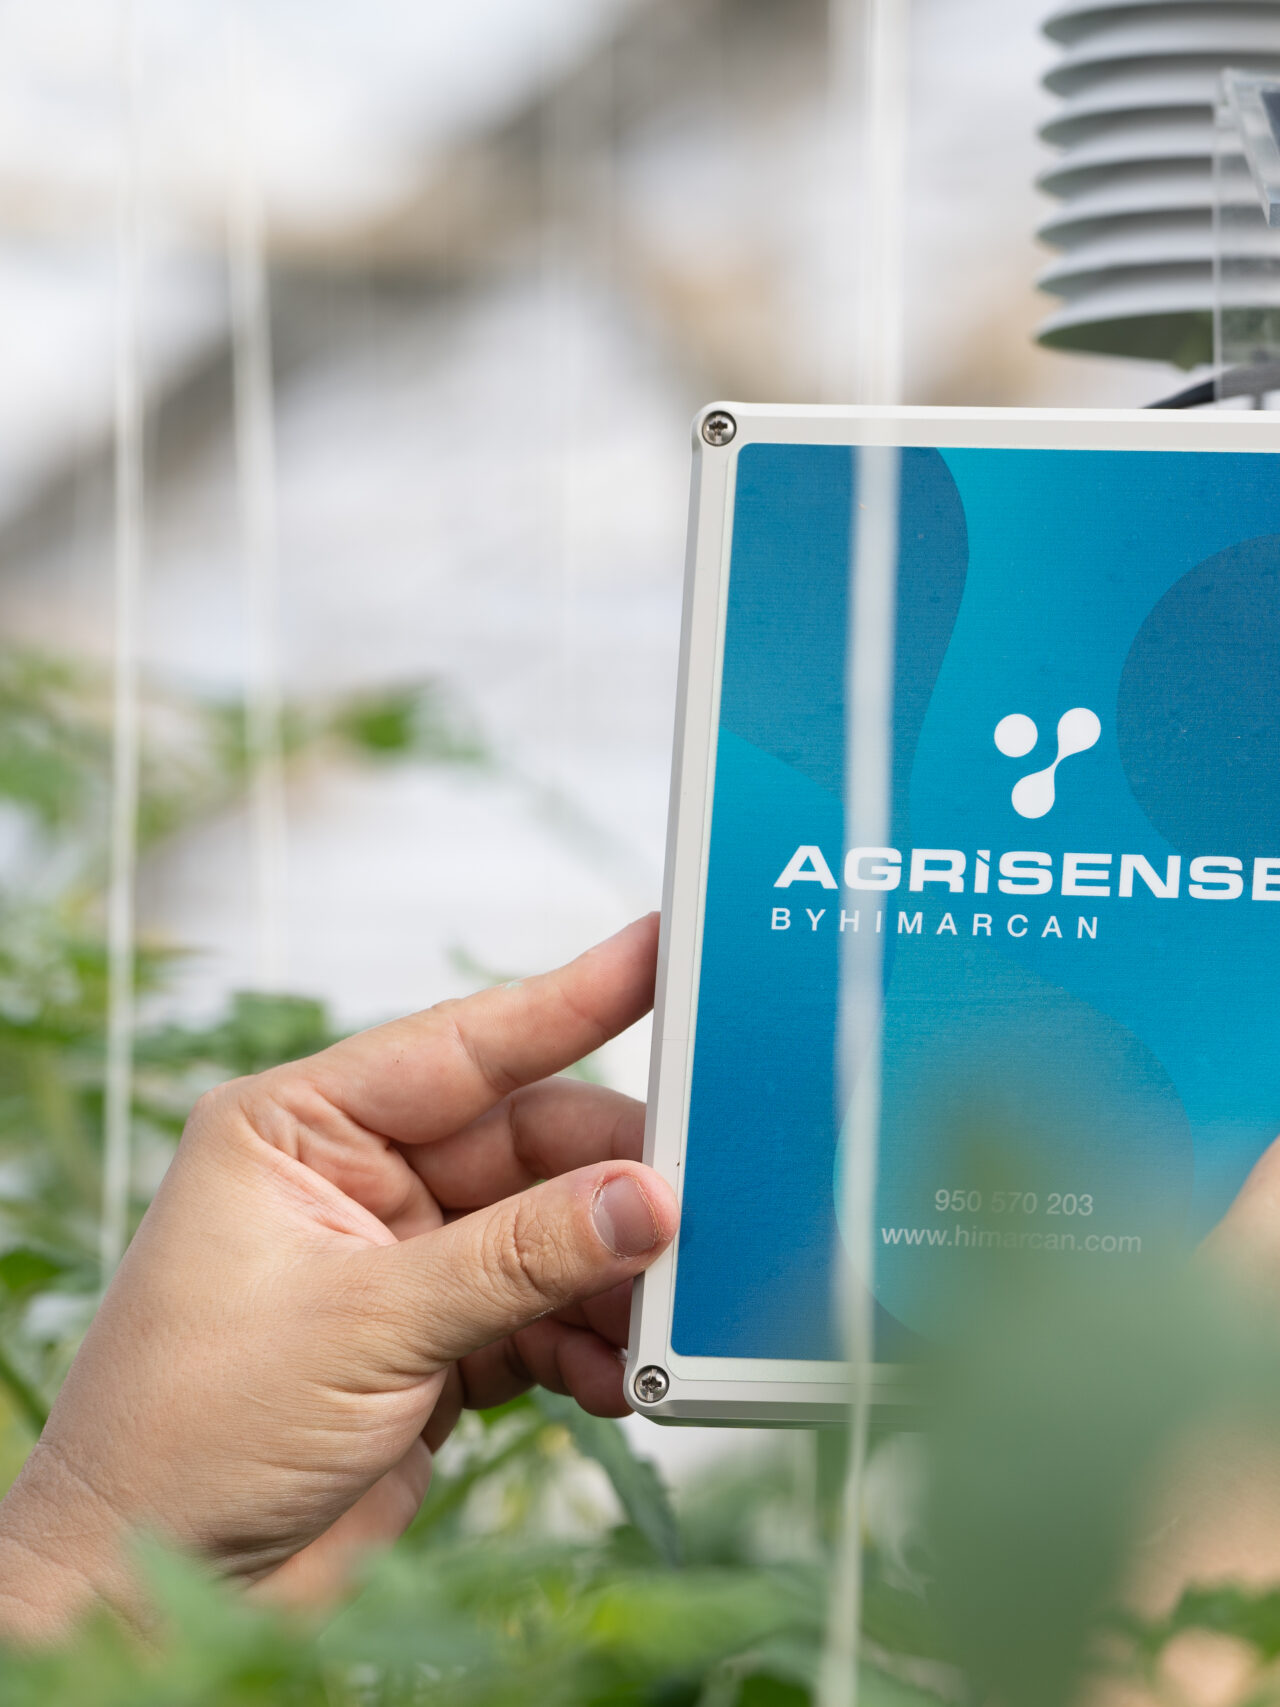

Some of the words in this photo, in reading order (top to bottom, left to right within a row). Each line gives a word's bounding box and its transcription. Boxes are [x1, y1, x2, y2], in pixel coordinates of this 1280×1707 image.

[935, 1189, 982, 1212] 950
[990, 1191, 1037, 1214] 570
[1046, 1193, 1095, 1216] 203
[881, 1224, 1142, 1253] www.himarcan.com
